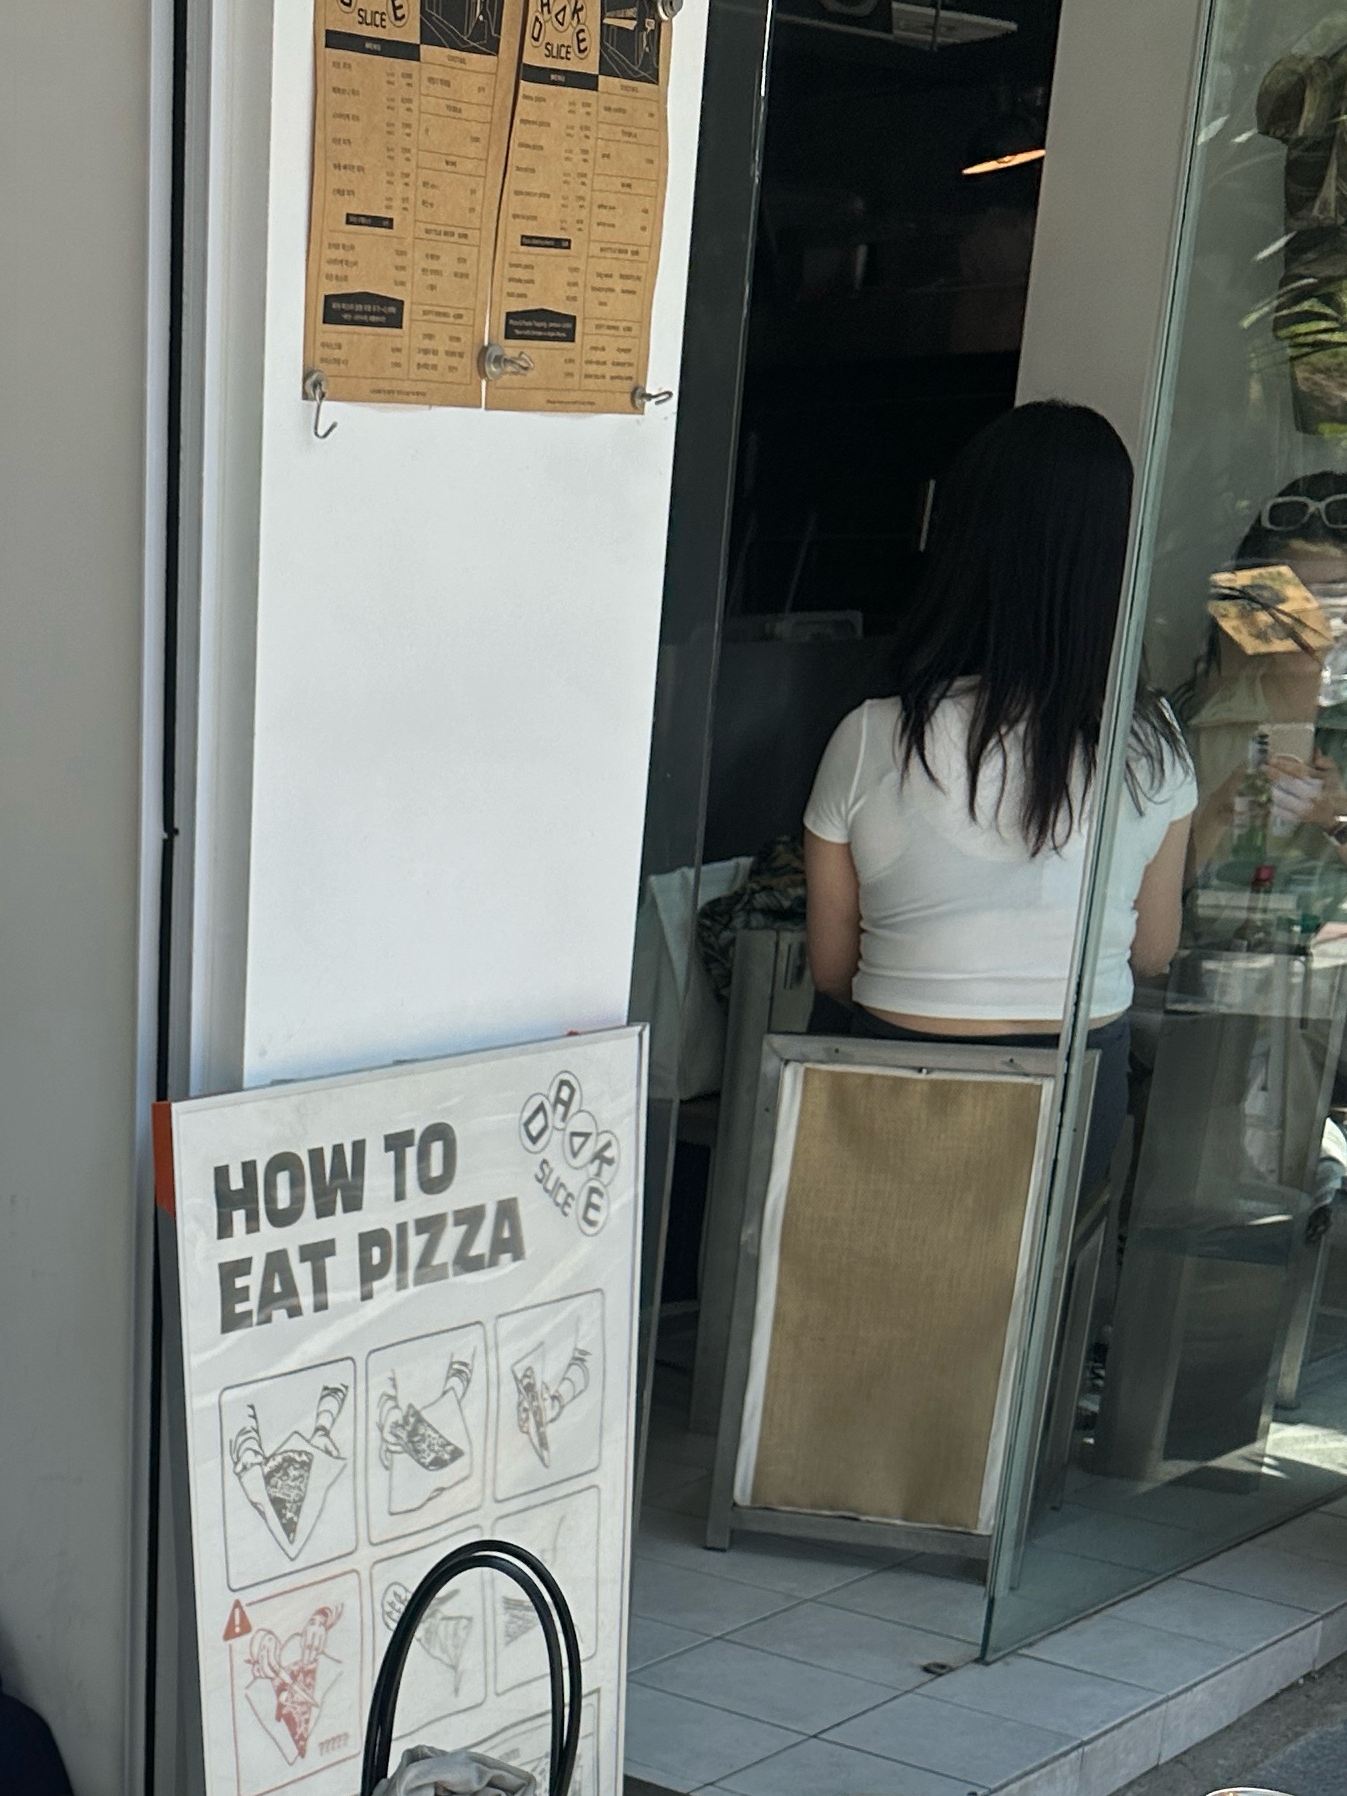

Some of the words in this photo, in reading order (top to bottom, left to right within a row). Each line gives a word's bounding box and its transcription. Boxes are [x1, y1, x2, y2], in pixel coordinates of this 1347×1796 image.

[357, 8, 387, 29] SLICE
[544, 41, 572, 61] SLICE
[212, 1138, 367, 1241] HOW
[383, 1121, 458, 1202] TO
[534, 1157, 576, 1218] SLICE
[217, 1238, 337, 1335] EAT
[357, 1196, 526, 1303] PIZZA
